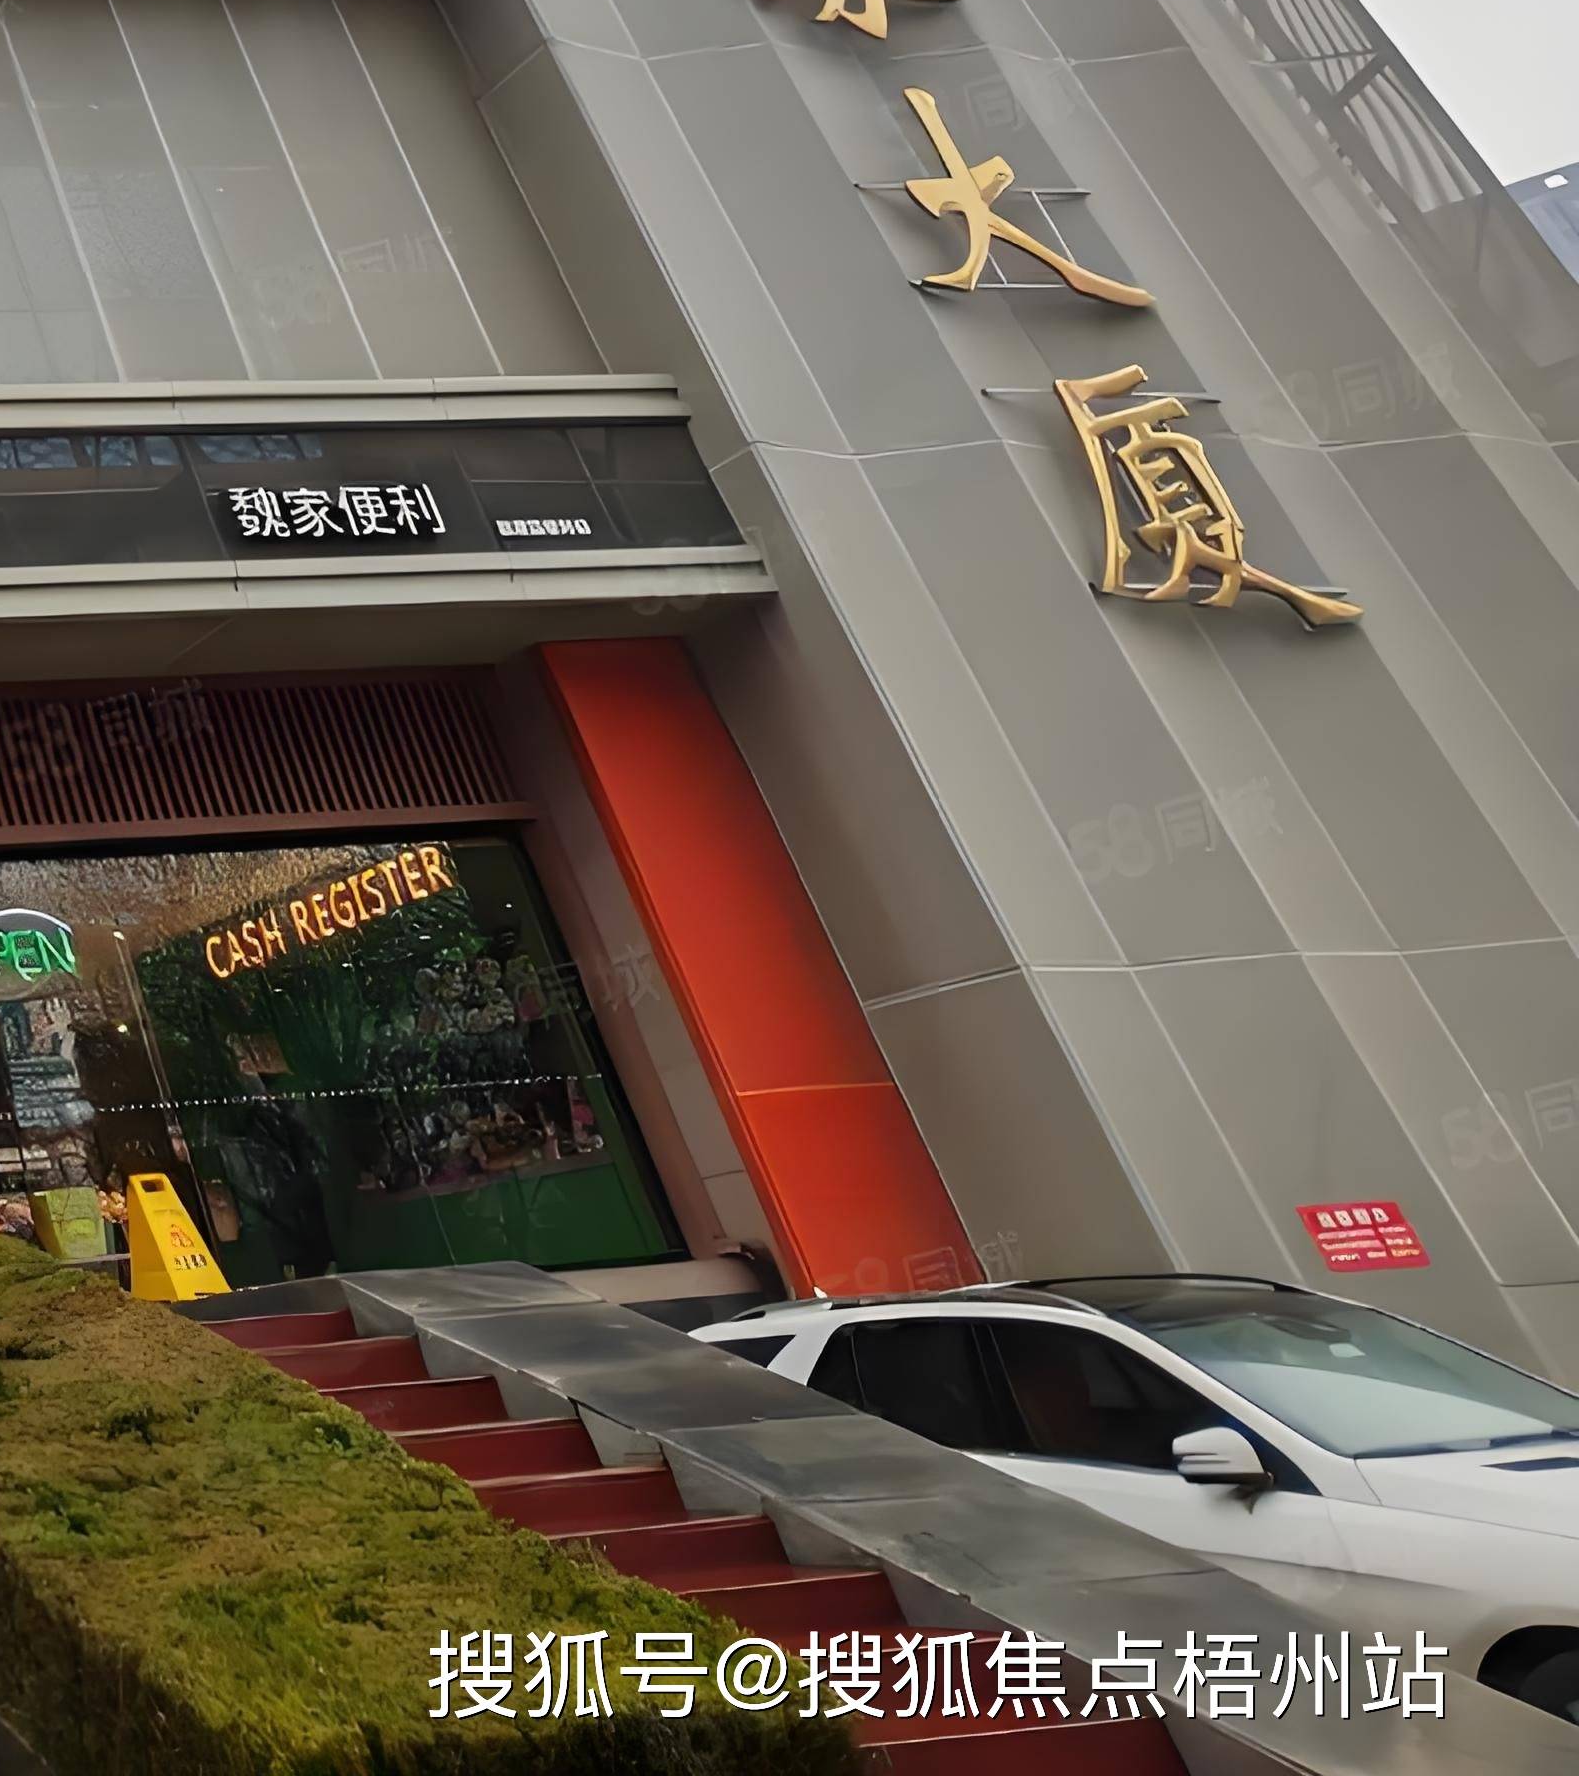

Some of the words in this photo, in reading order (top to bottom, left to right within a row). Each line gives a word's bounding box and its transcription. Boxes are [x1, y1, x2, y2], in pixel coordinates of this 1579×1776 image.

[227, 483, 447, 538] 魏家便利
[204, 907, 288, 979] CASH
[289, 845, 454, 946] REGISTER
